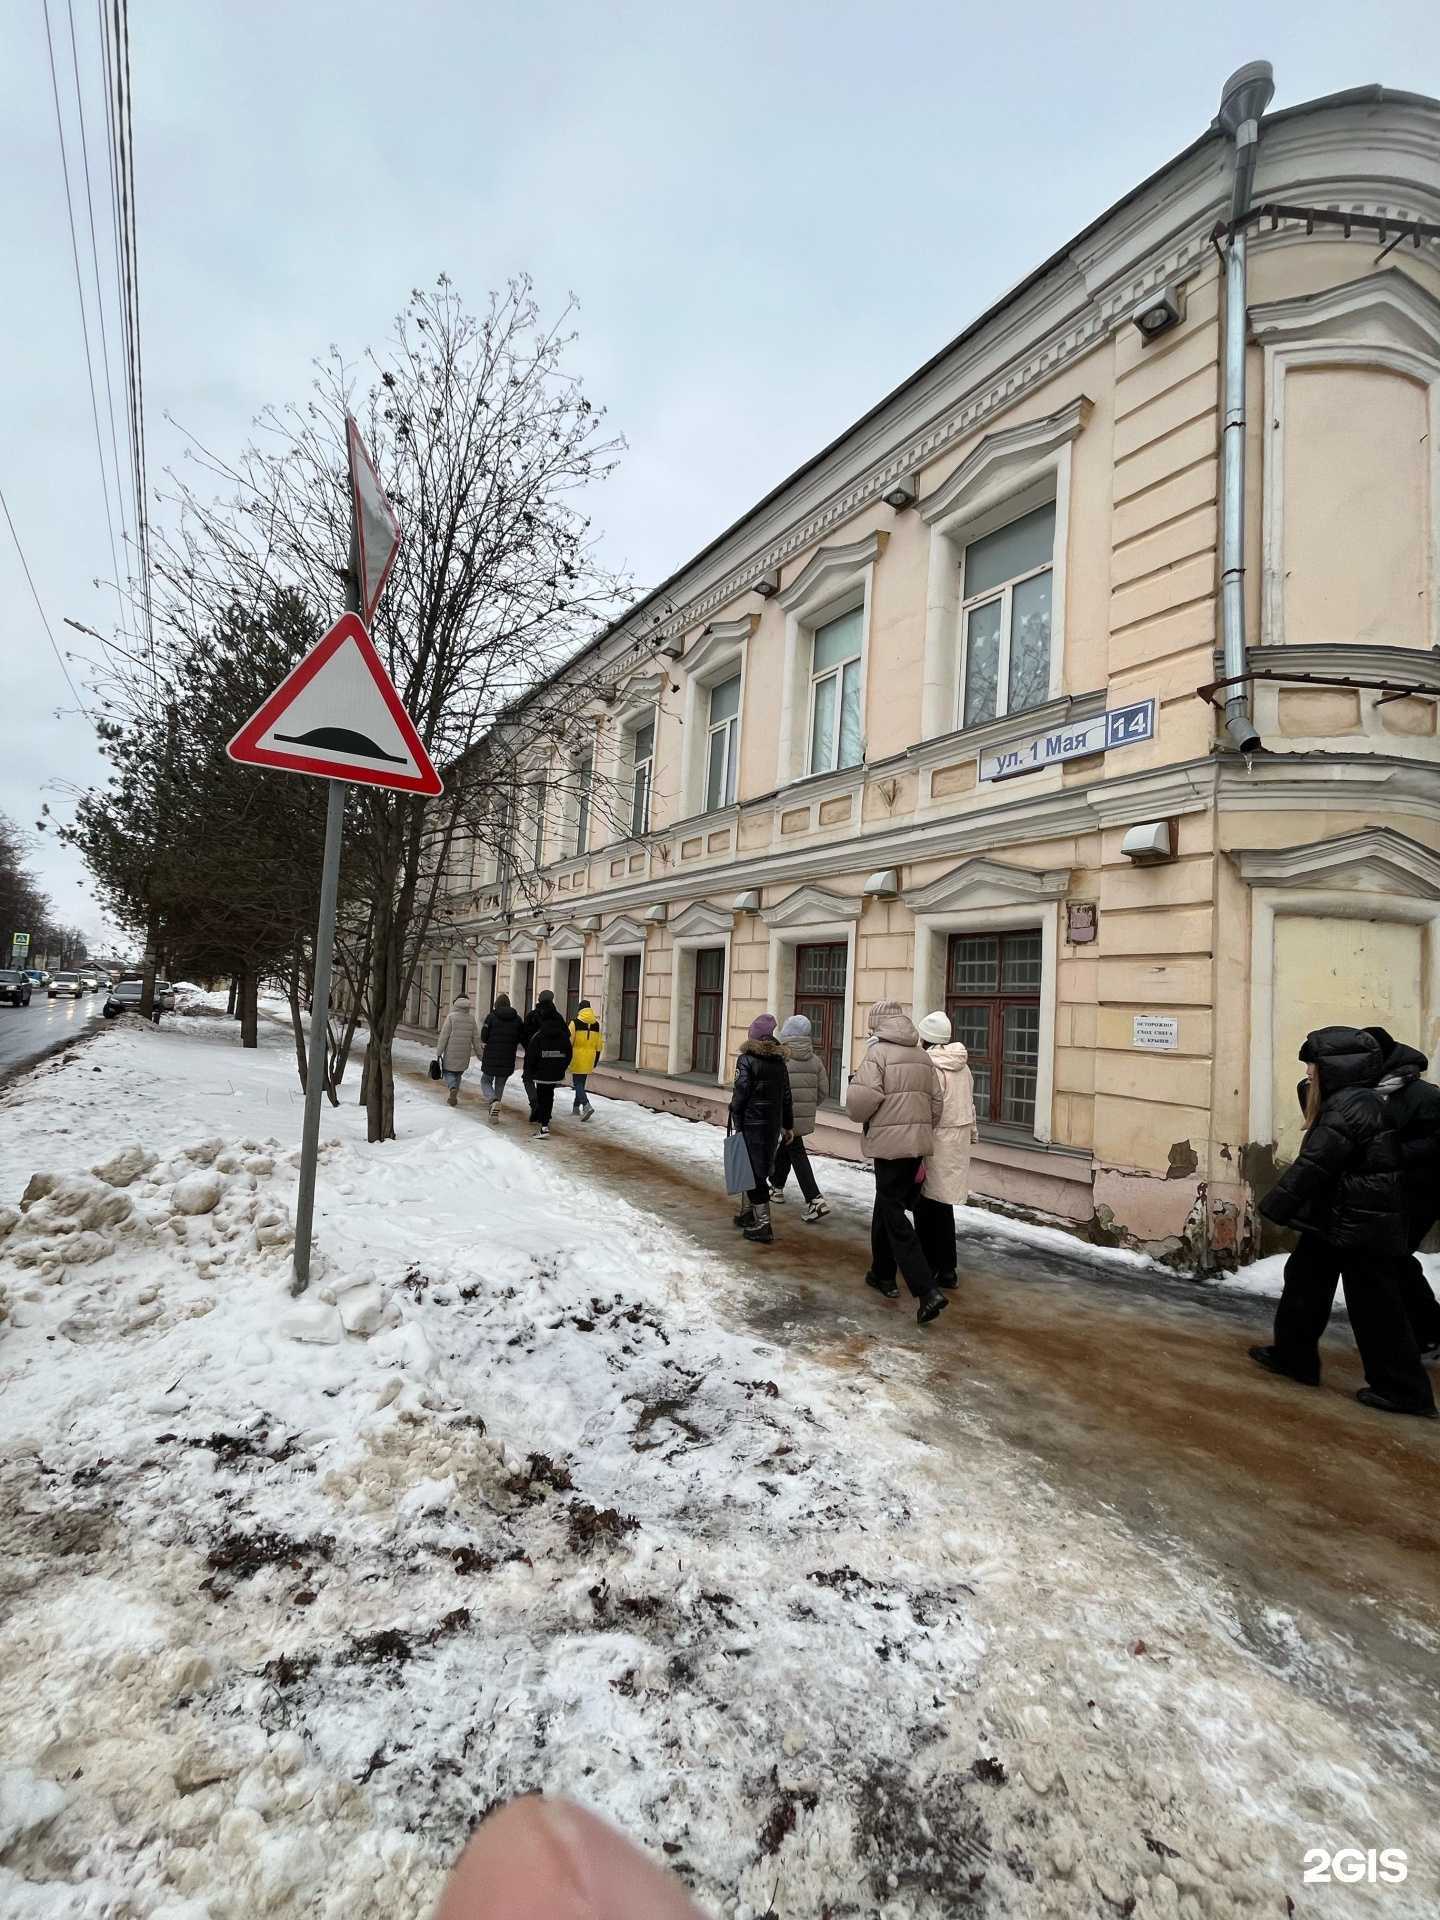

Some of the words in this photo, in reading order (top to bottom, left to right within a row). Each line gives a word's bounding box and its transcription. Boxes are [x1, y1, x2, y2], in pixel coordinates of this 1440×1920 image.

[995, 751, 1023, 774] ул.
[1030, 741, 1037, 761] 1
[1046, 732, 1087, 757] Мая
[1113, 712, 1146, 738] 14
